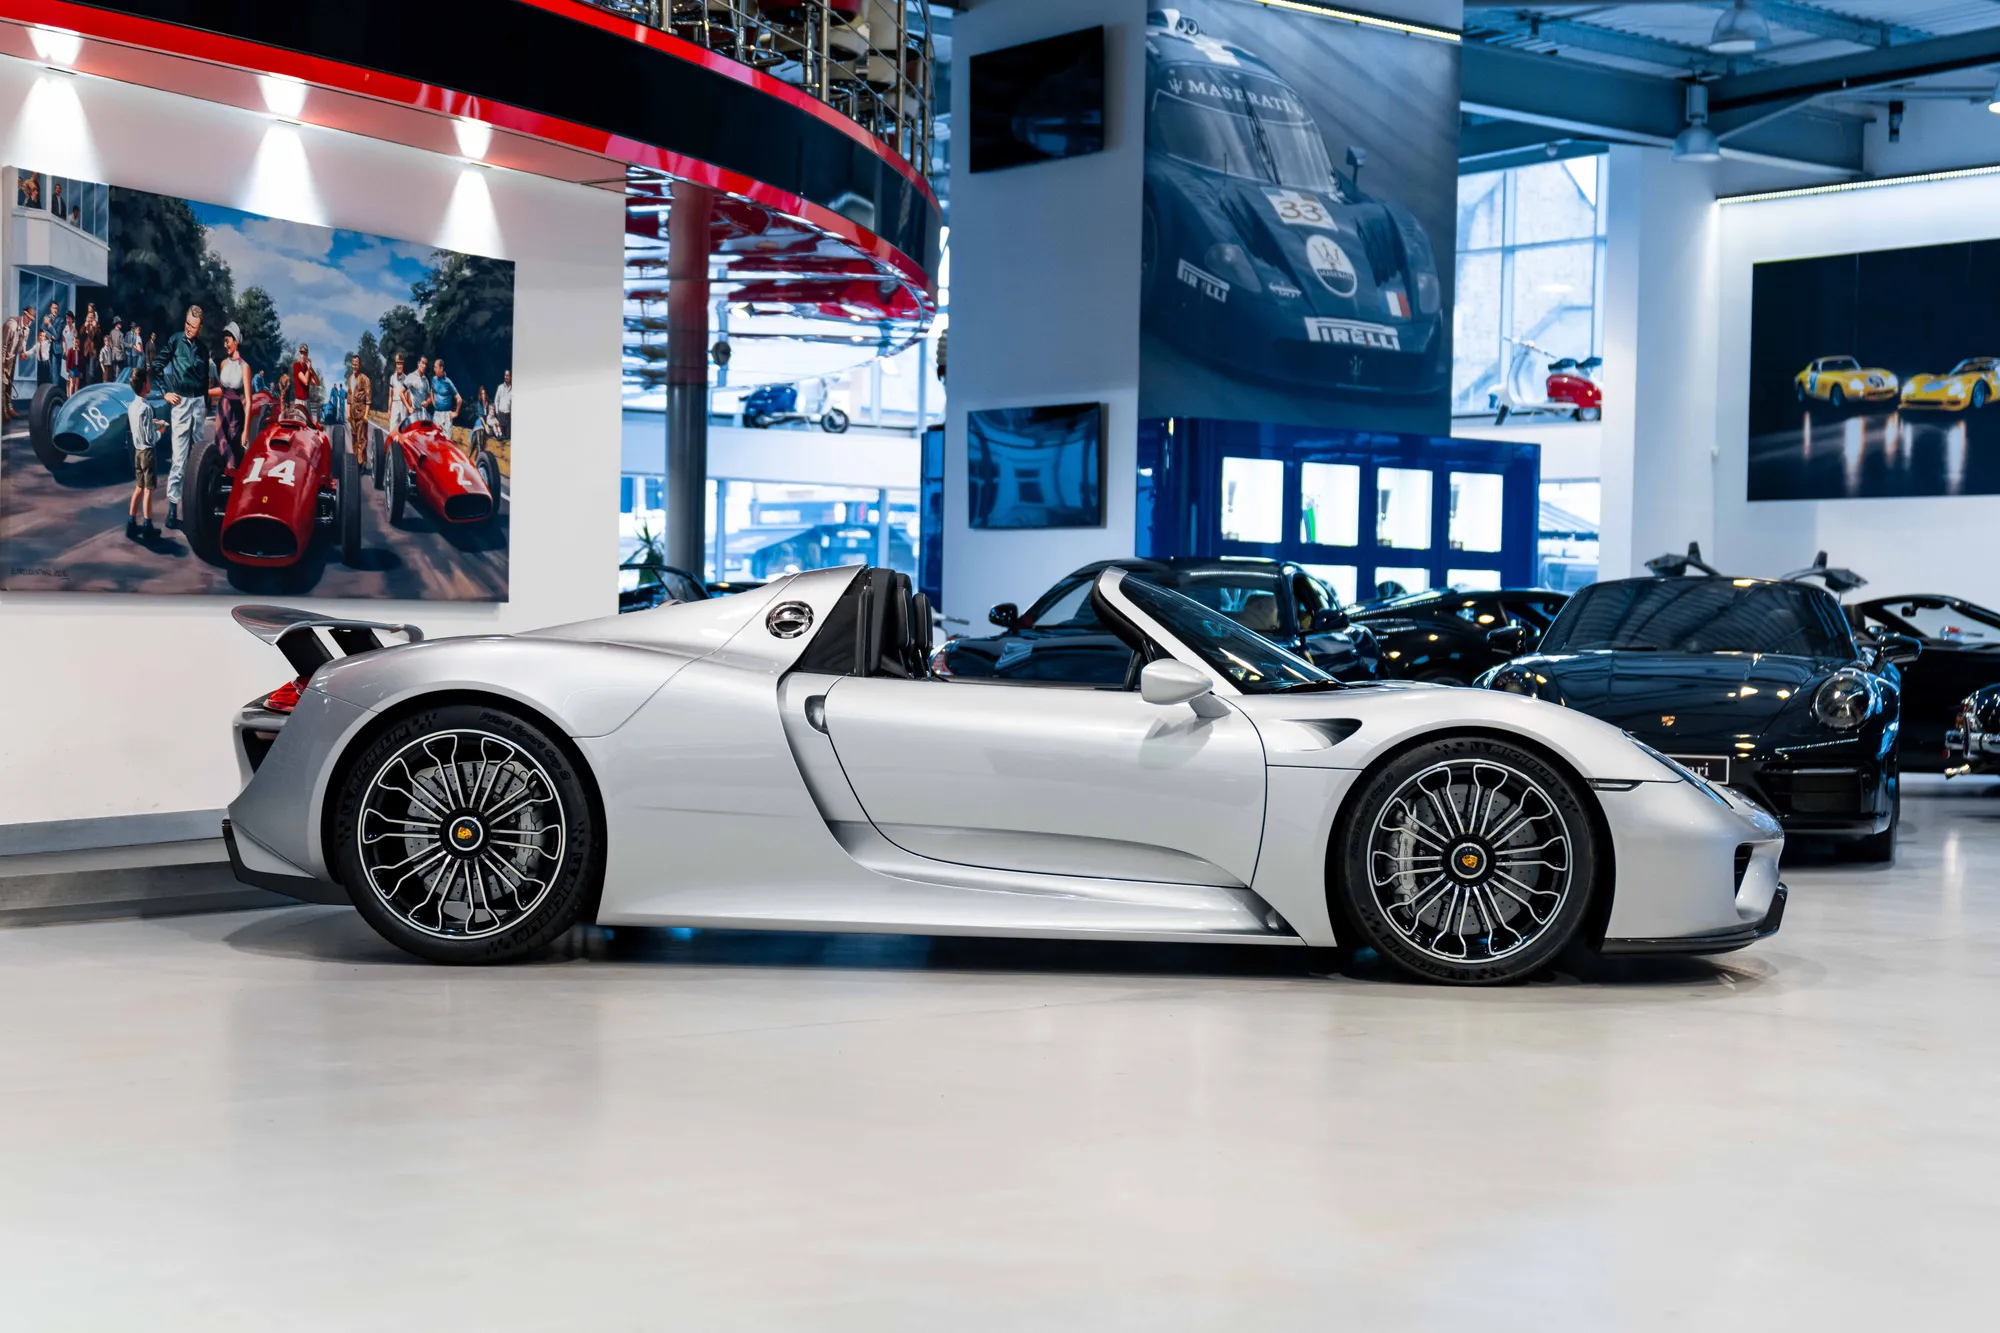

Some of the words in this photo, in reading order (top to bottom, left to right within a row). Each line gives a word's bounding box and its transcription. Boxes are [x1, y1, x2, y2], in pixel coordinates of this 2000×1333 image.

[1188, 79, 1292, 113] MASERATI
[1279, 201, 1323, 222] 33
[1304, 316, 1401, 352] PIRELLI
[81, 406, 110, 432] 18
[242, 457, 296, 487] 14
[449, 462, 473, 486] 2
[348, 726, 407, 795] MICHELIN
[1489, 744, 1559, 786] MICHELIN
